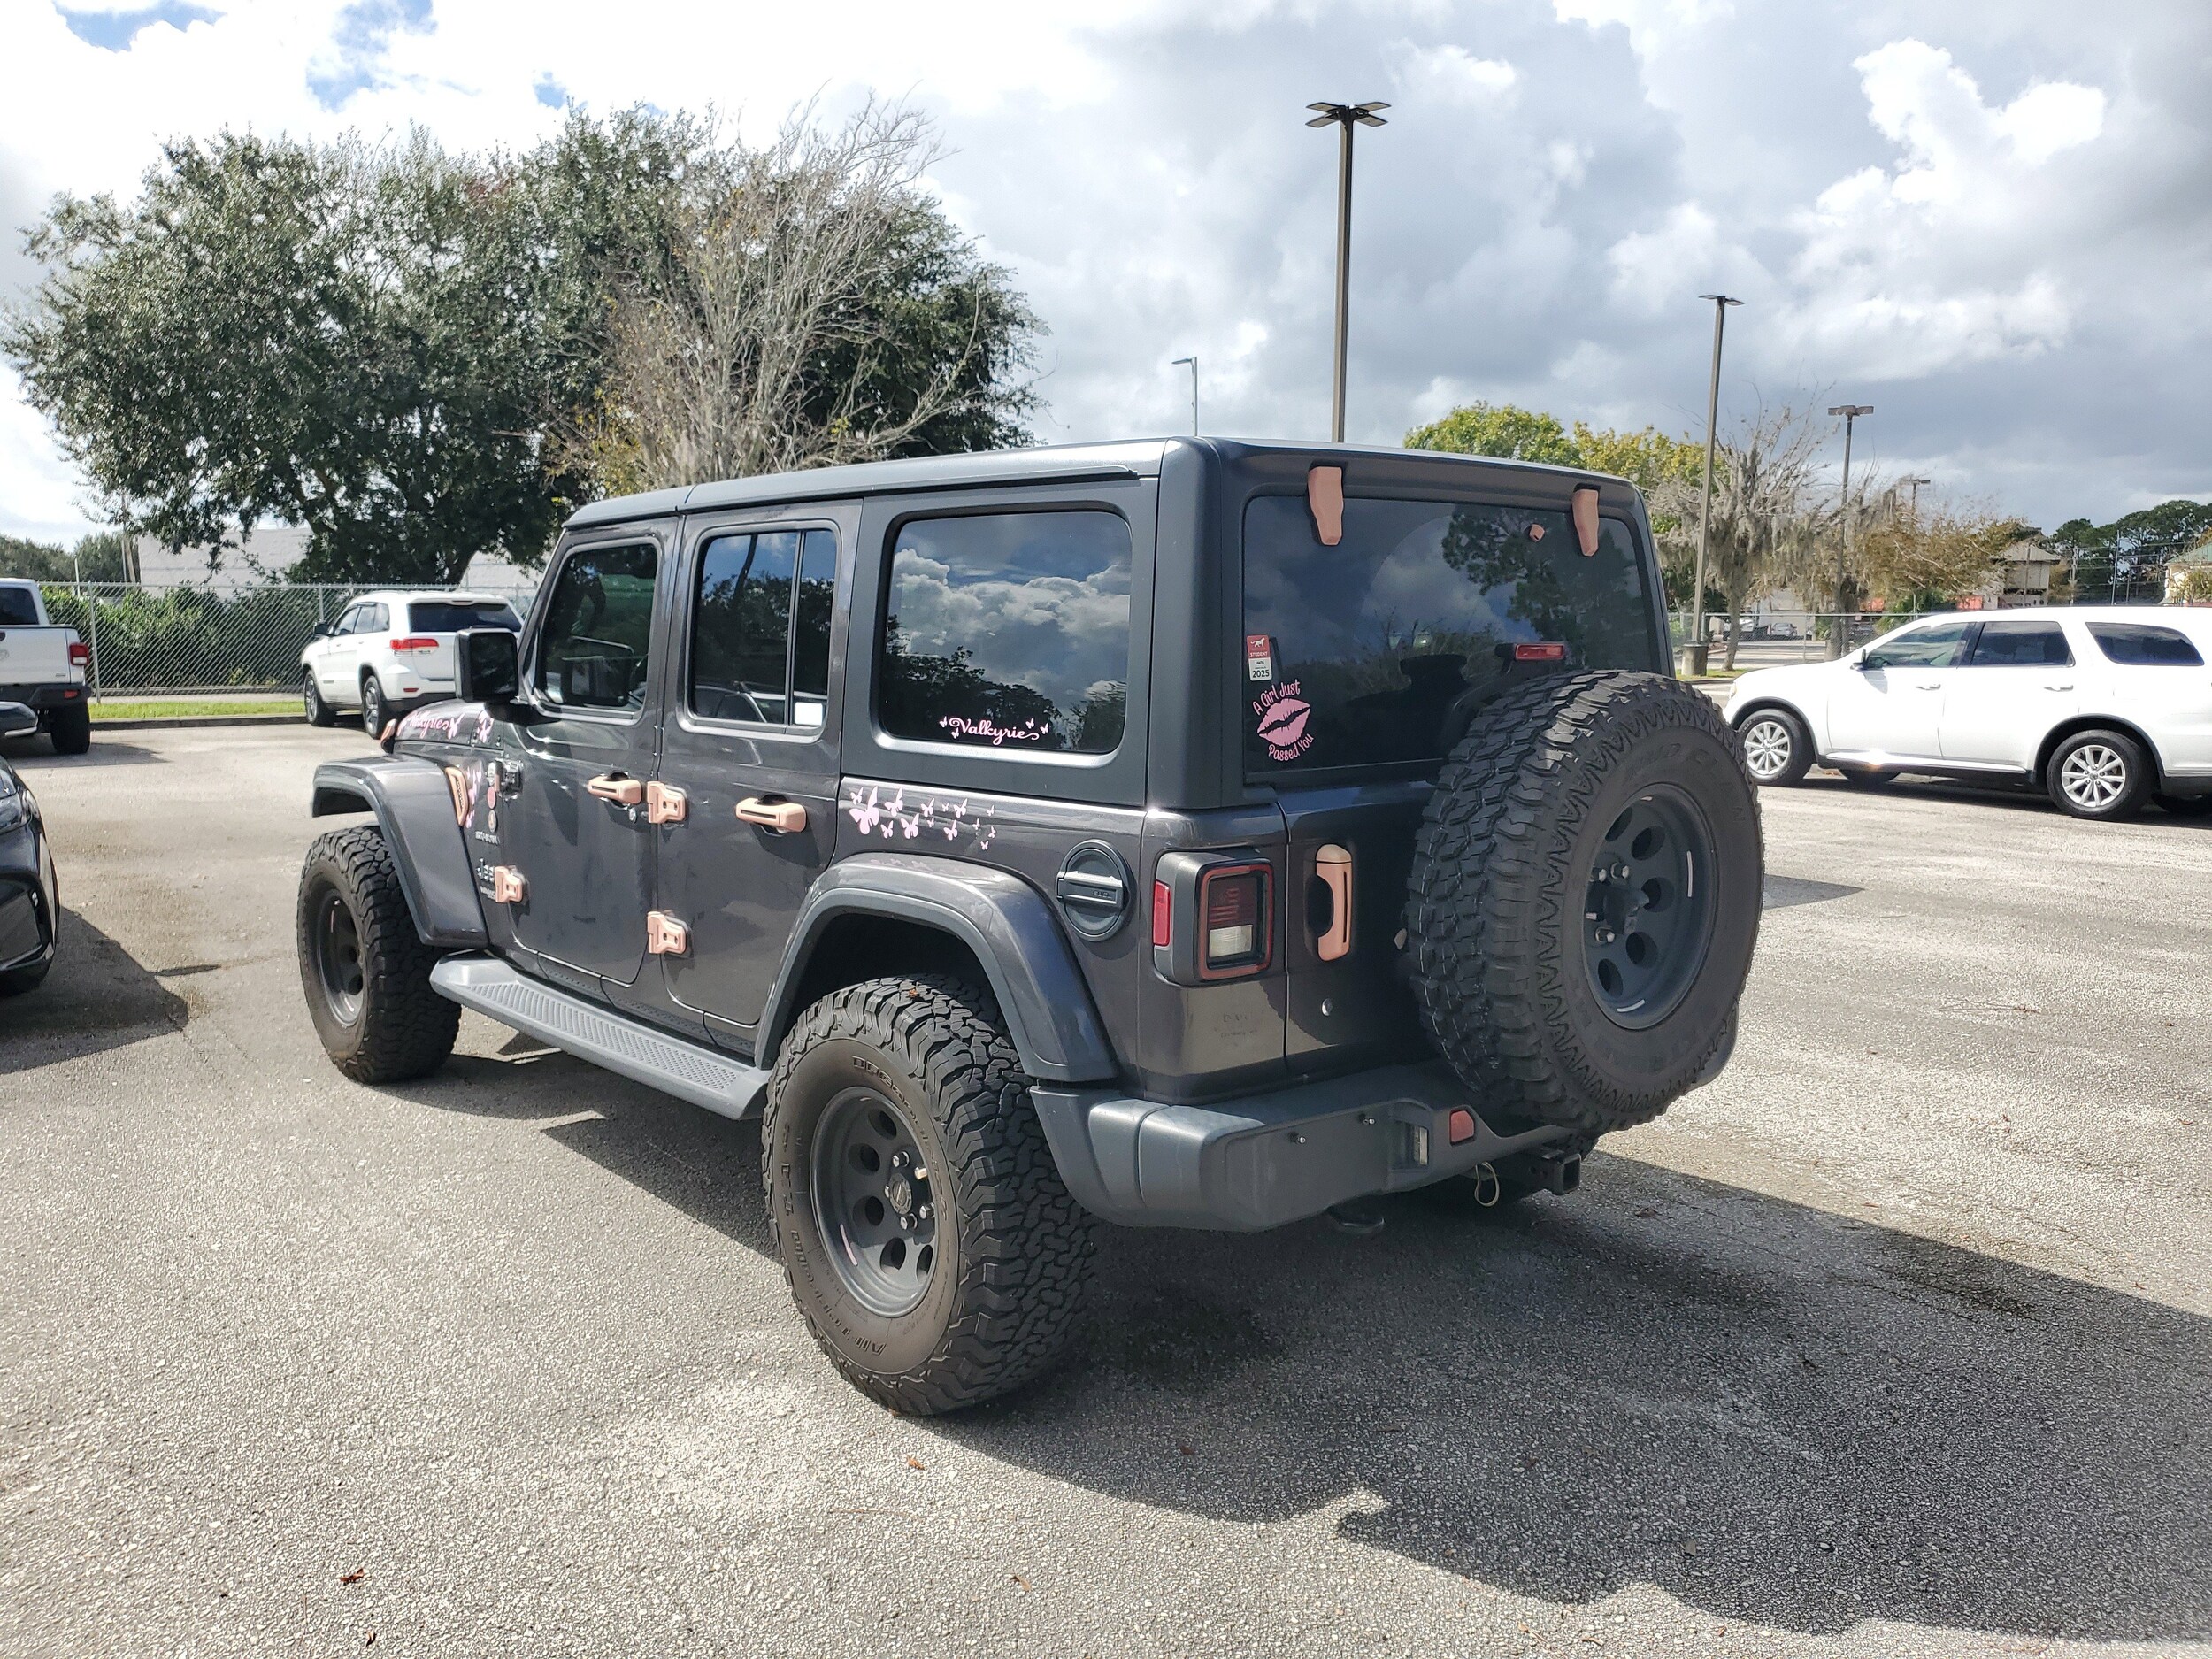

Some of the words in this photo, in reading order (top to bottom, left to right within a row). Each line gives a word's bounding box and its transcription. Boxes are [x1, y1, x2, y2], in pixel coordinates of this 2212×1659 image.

[1252, 669, 1270, 678] 2025
[1253, 701, 1263, 716] A
[1260, 686, 1279, 706] Girl
[1279, 679, 1301, 696] Just
[949, 717, 1040, 746] Valkyrie
[1268, 743, 1300, 762] Passed
[1297, 733, 1314, 752] You
[475, 858, 495, 882] Jee
